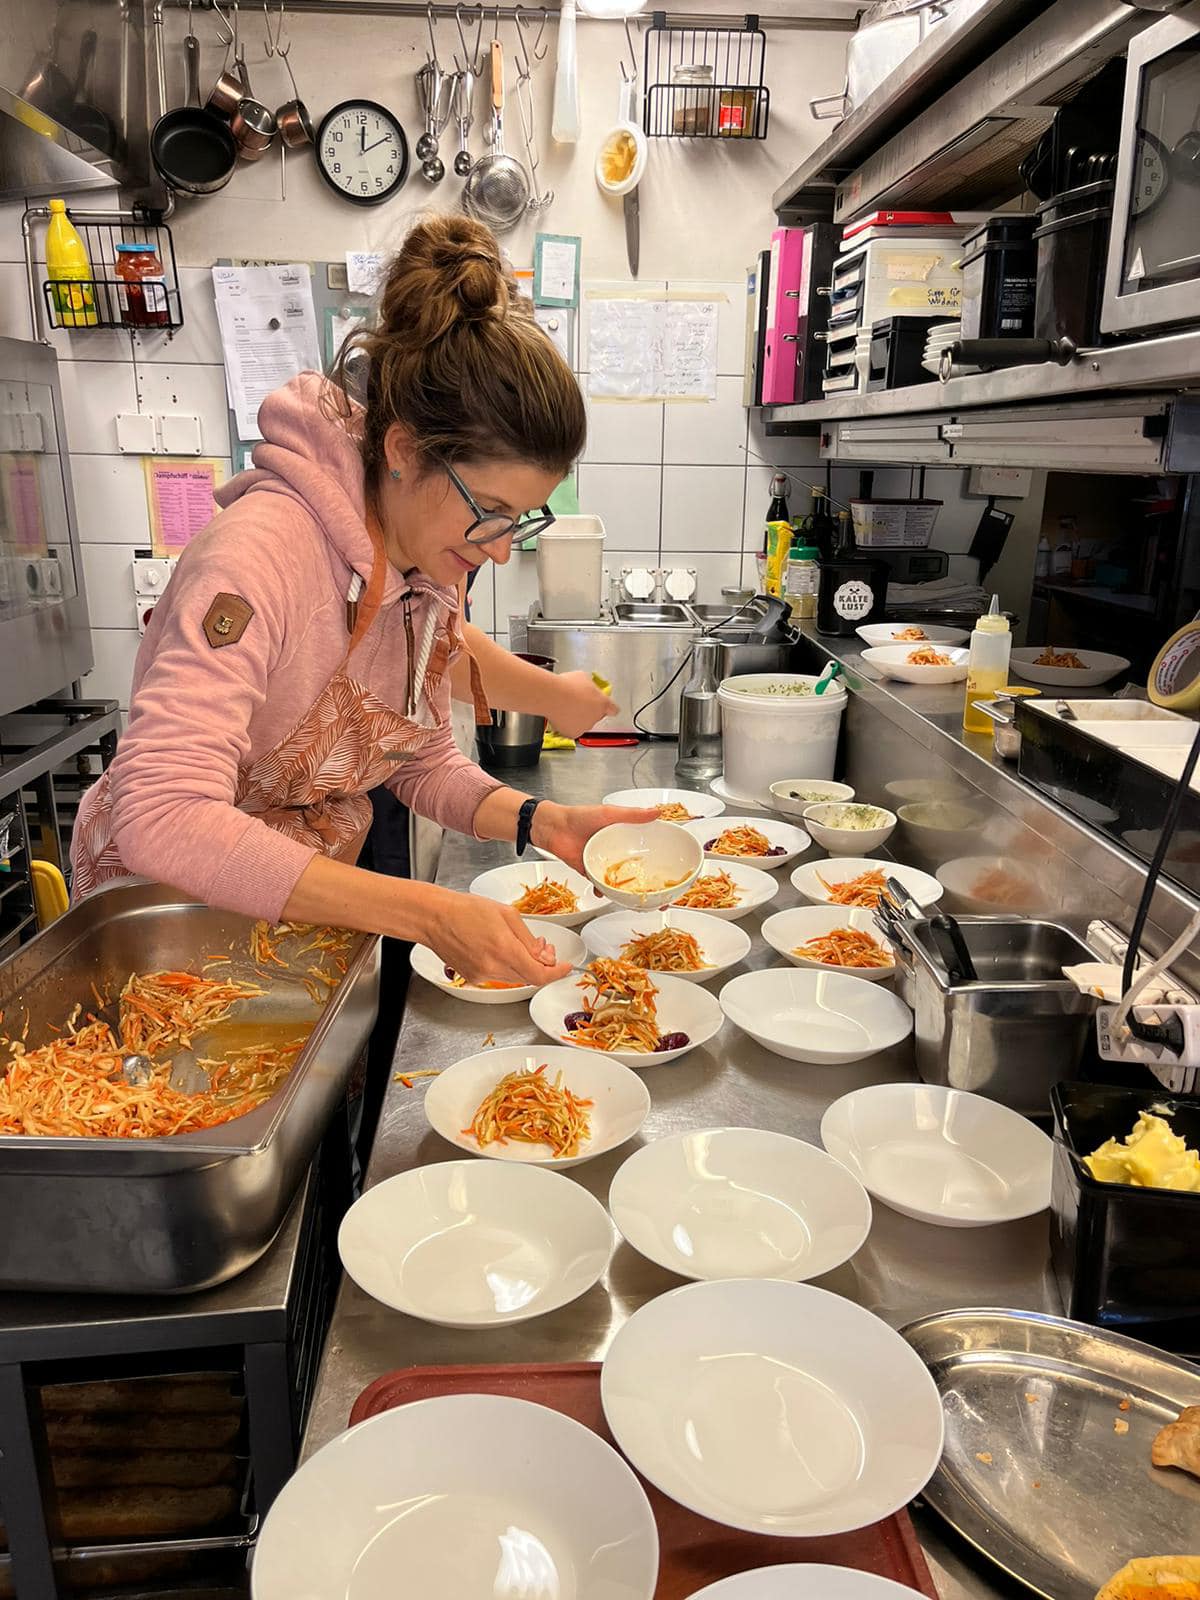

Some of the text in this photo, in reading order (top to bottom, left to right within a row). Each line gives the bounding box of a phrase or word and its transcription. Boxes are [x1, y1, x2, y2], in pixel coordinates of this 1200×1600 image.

[343, 119, 351, 129] 11
[356, 115, 368, 125] 12
[375, 120, 380, 130] 1
[332, 132, 343, 143] 10
[384, 132, 392, 143] 2
[328, 147, 336, 157] 9
[391, 149, 398, 159] 3
[333, 162, 341, 174] 8
[386, 164, 394, 174] 4
[345, 175, 353, 186] 7
[375, 177, 383, 187] 5
[360, 181, 368, 191] 6
[839, 595, 869, 603] KALTE
[841, 603, 865, 611] LUST
